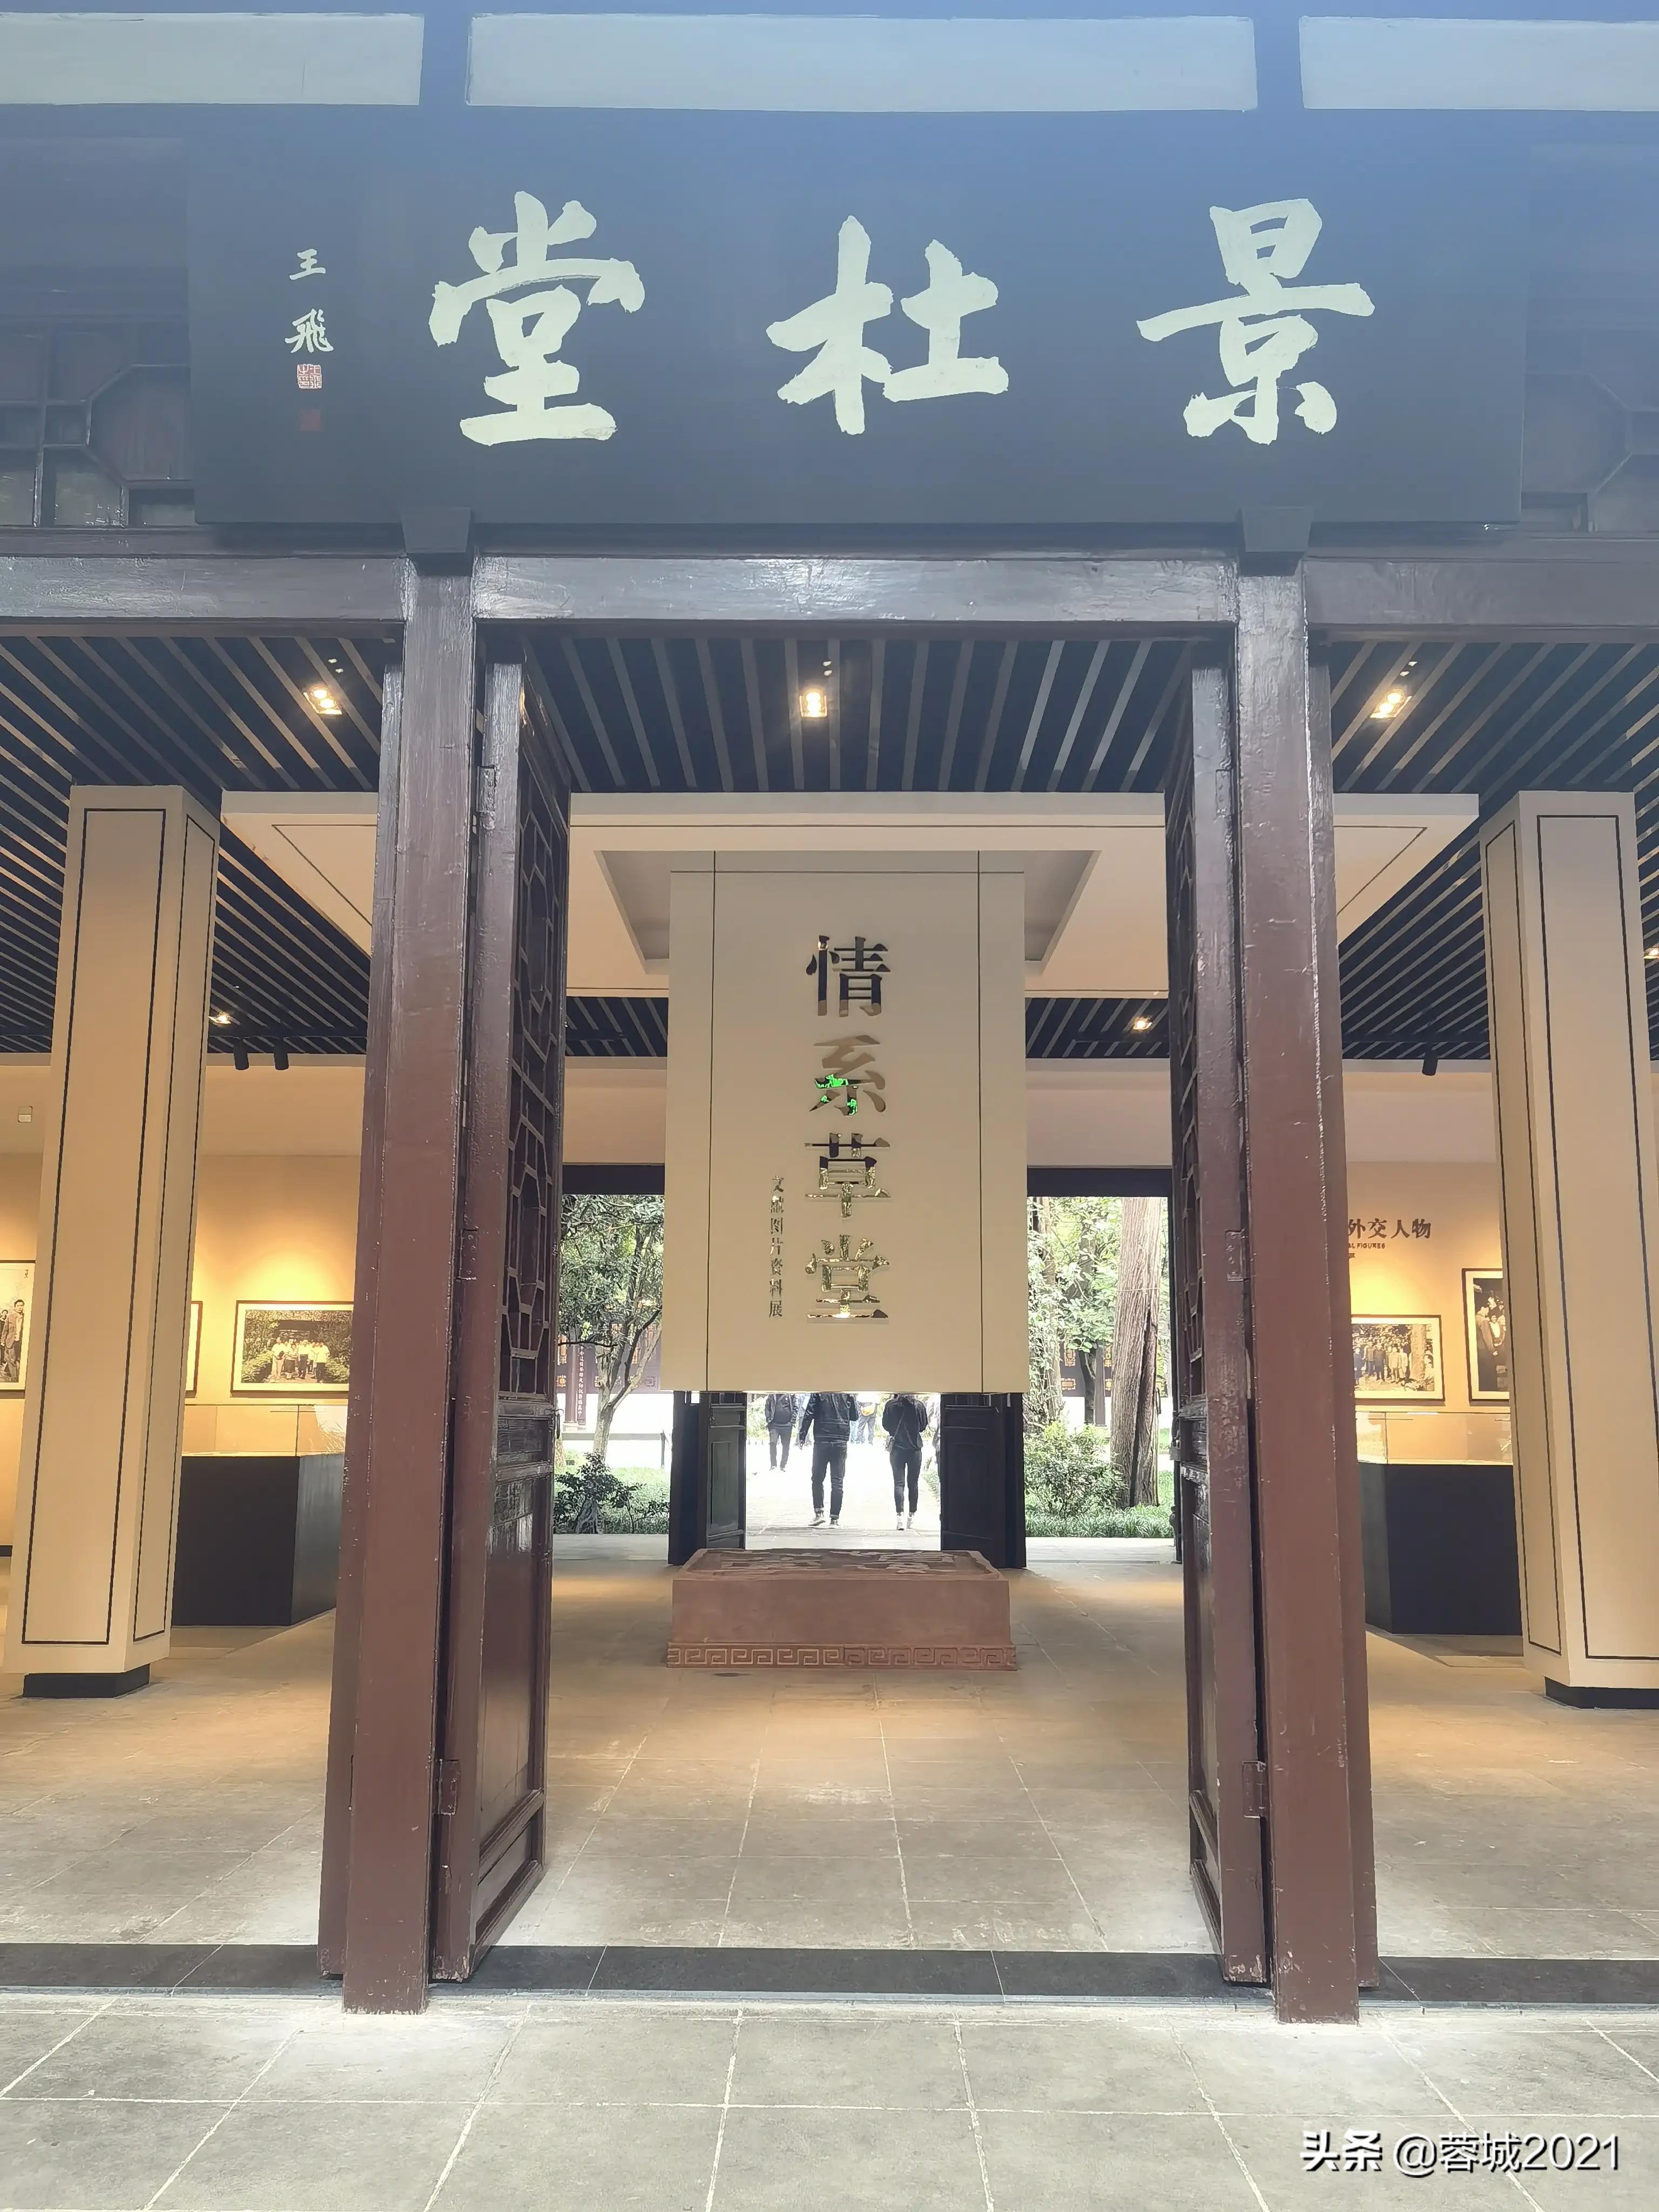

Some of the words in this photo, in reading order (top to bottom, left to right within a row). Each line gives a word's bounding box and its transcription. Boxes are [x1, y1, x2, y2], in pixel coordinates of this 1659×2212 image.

[428, 191, 1375, 446] 景杜堂
[804, 935, 891, 1321] 情系草堂
[769, 1175, 784, 1318] 文献图片资料展
[1348, 1218, 1431, 1239] 外交人物
